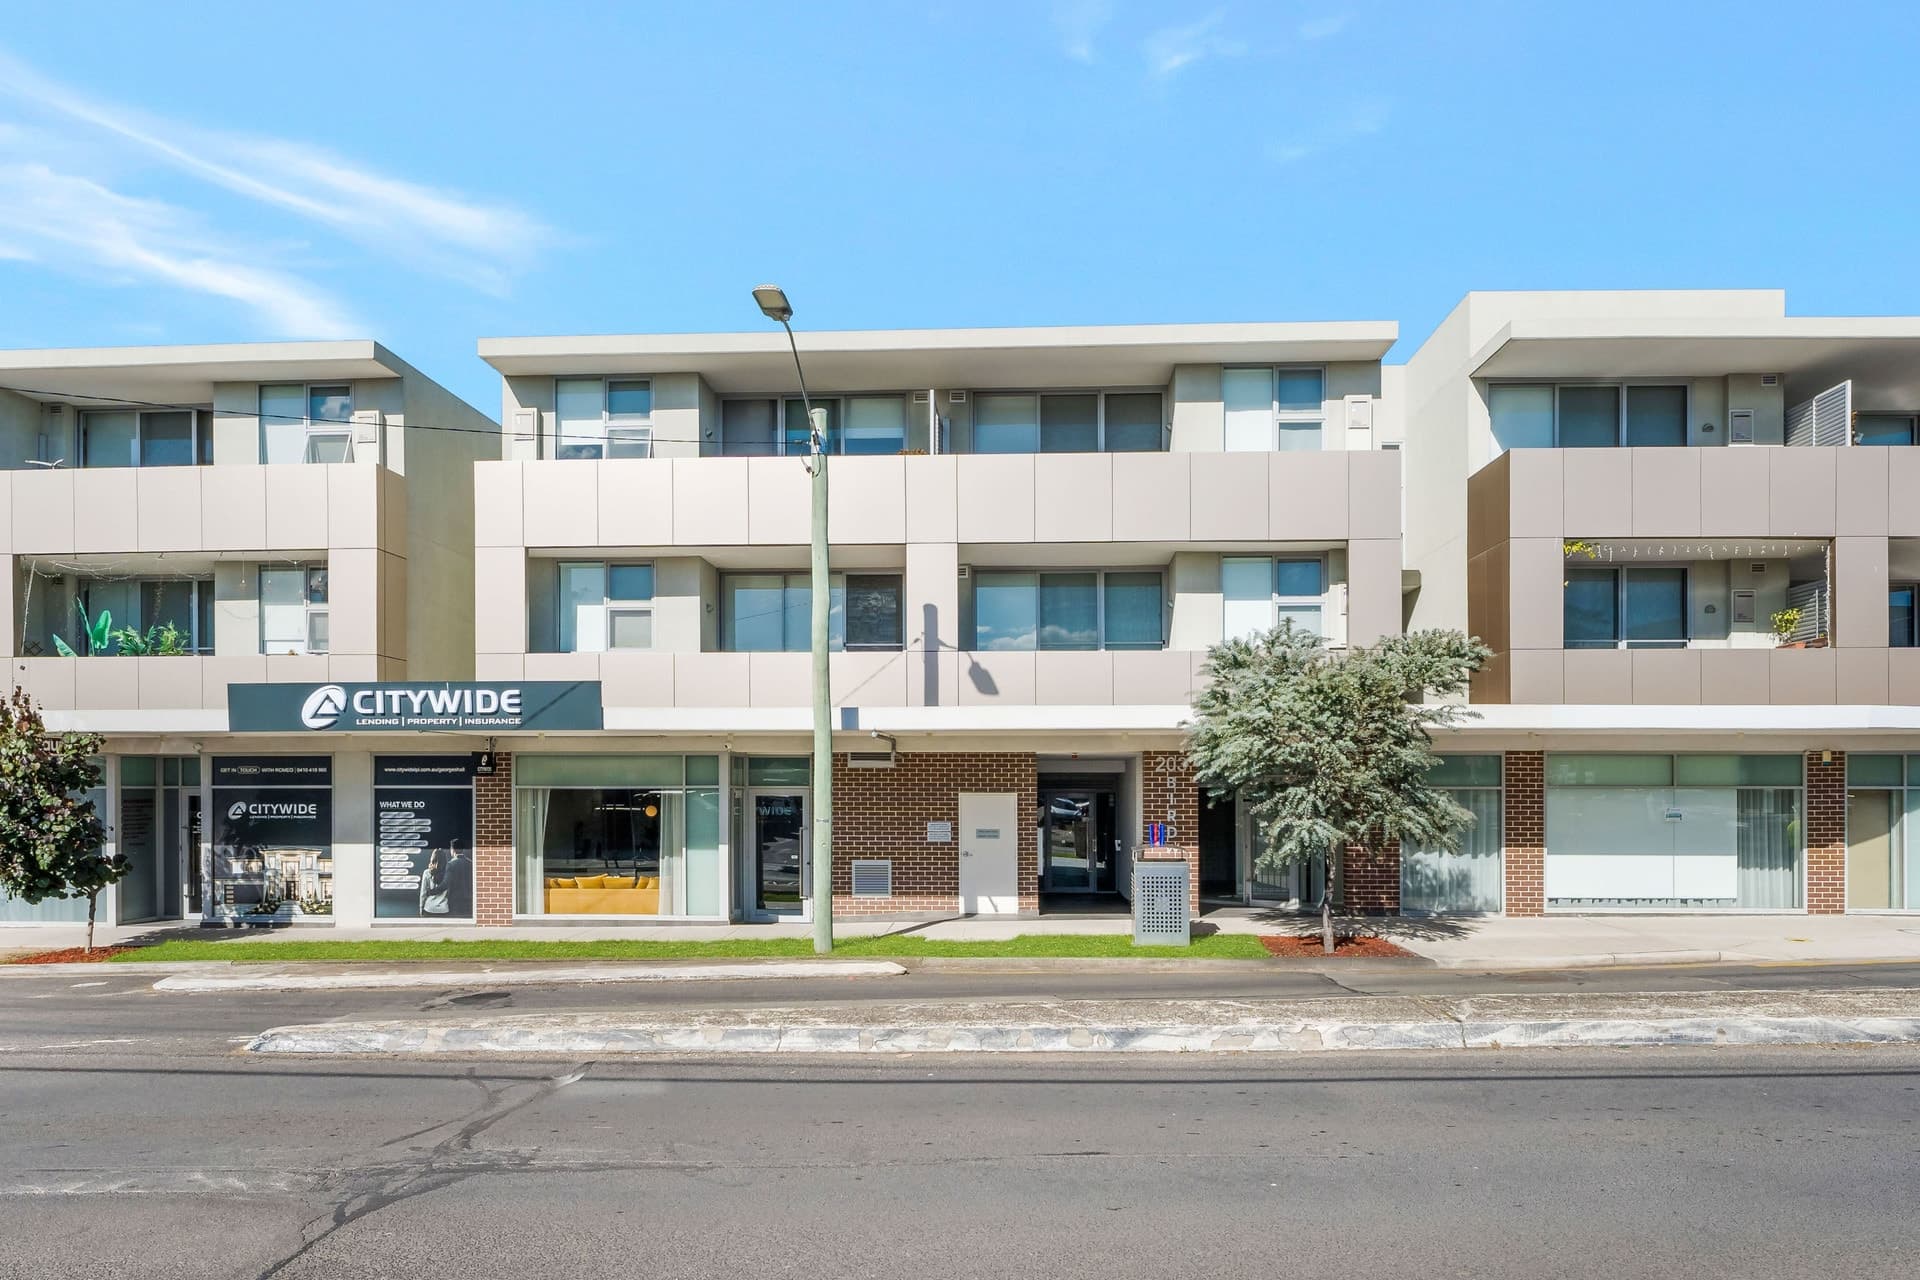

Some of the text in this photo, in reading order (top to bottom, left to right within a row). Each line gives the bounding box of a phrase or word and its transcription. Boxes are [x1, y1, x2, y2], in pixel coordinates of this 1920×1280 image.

[353, 689, 522, 714] CITYWIDE
[464, 717, 522, 725] INSURANCE
[249, 803, 317, 814] CITYWIDE
